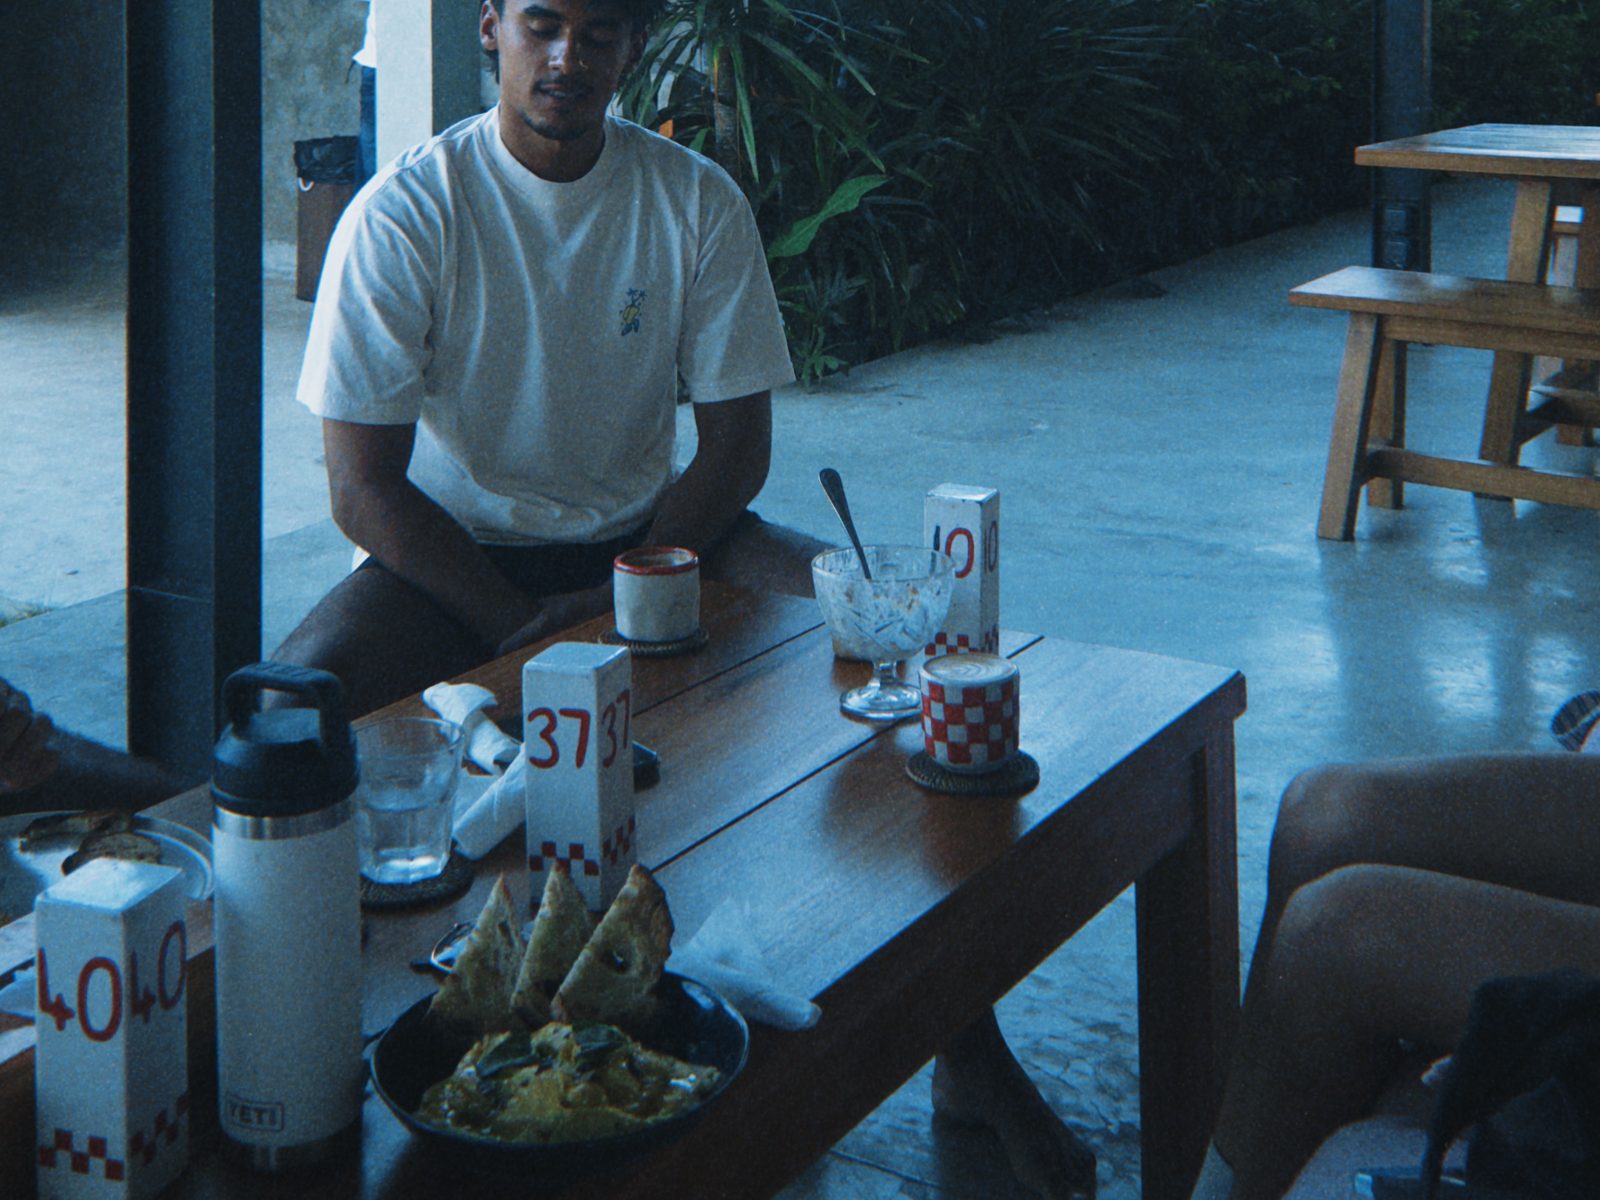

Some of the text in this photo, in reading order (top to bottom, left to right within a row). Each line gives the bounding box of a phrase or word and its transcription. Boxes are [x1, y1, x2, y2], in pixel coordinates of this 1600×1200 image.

[527, 707, 591, 769] 37
[601, 688, 631, 768] 37
[37, 946, 123, 1043] 40
[130, 919, 187, 1023] 40
[229, 1101, 277, 1125] YETI
